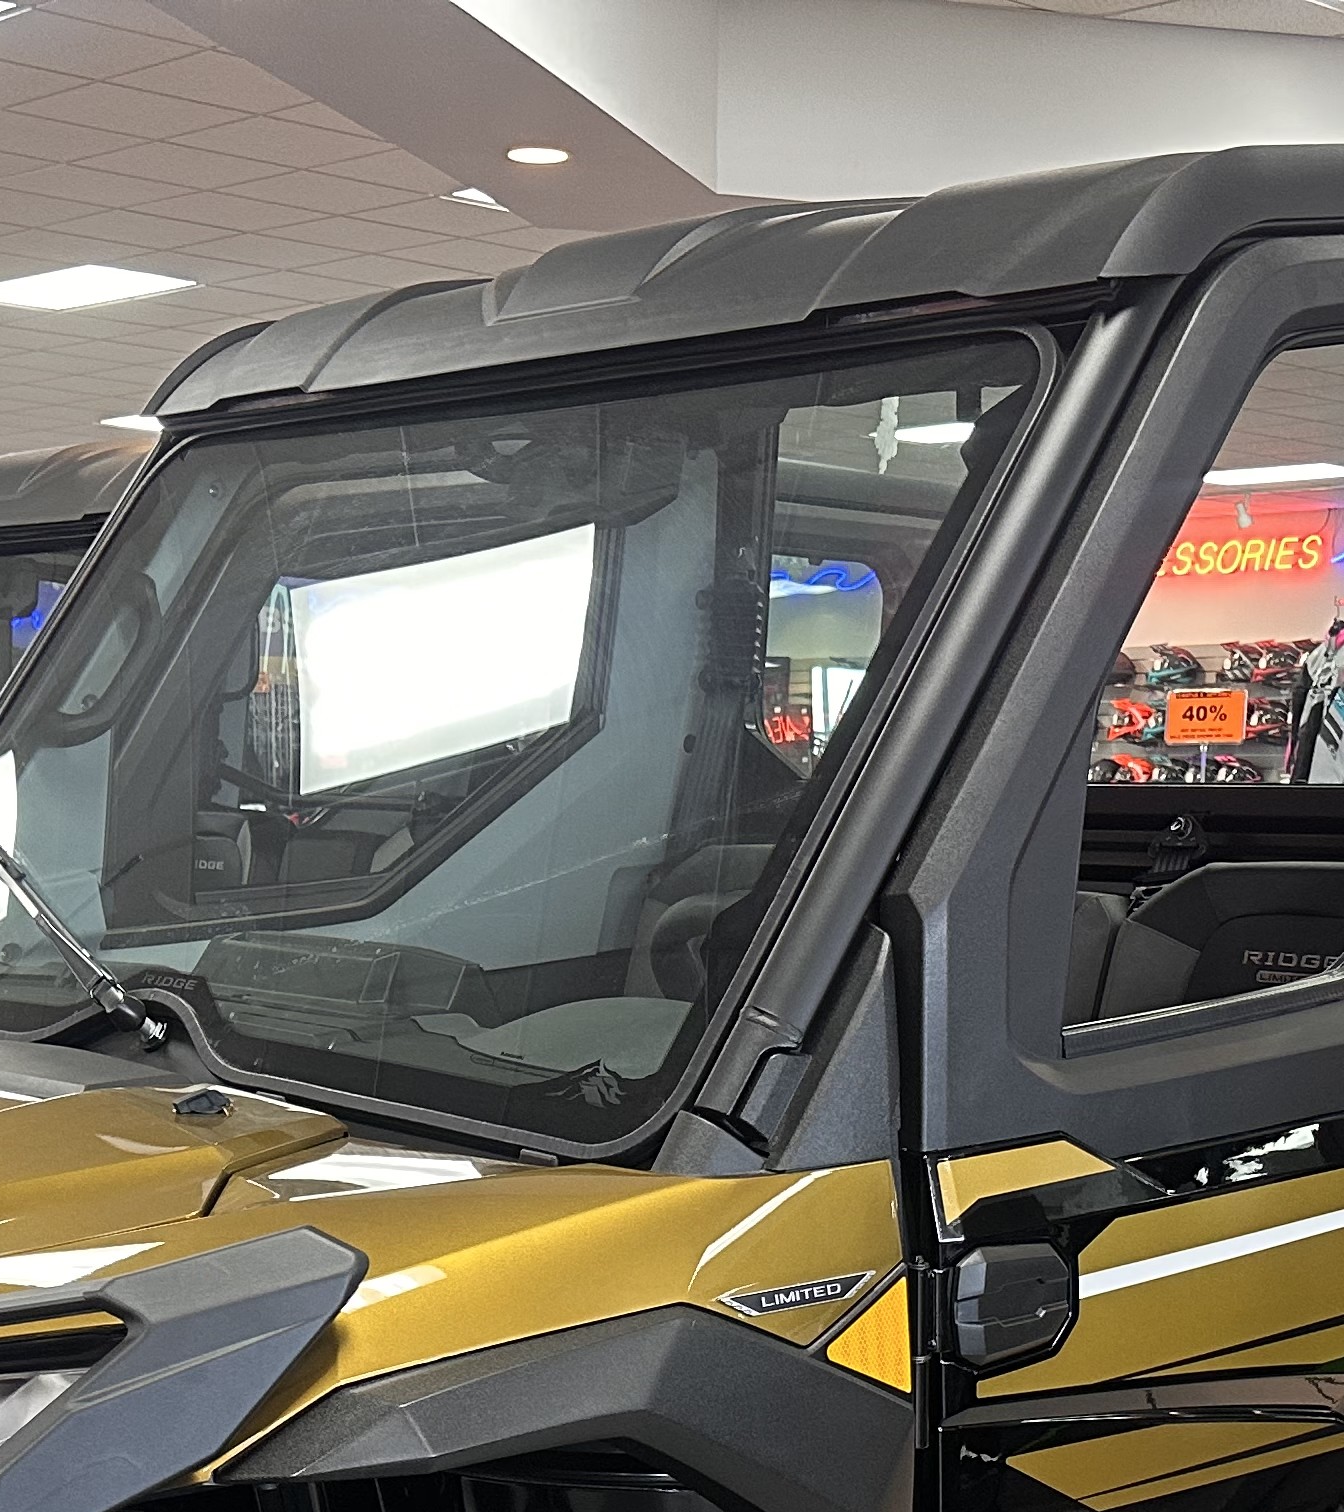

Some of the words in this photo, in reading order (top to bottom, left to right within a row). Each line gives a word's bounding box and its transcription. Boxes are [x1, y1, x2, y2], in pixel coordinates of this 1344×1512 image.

[1157, 535, 1323, 576] SSORIES
[1181, 704, 1228, 722] 40%
[142, 972, 198, 991] RIDGE
[761, 1283, 842, 1308] LIMITED
